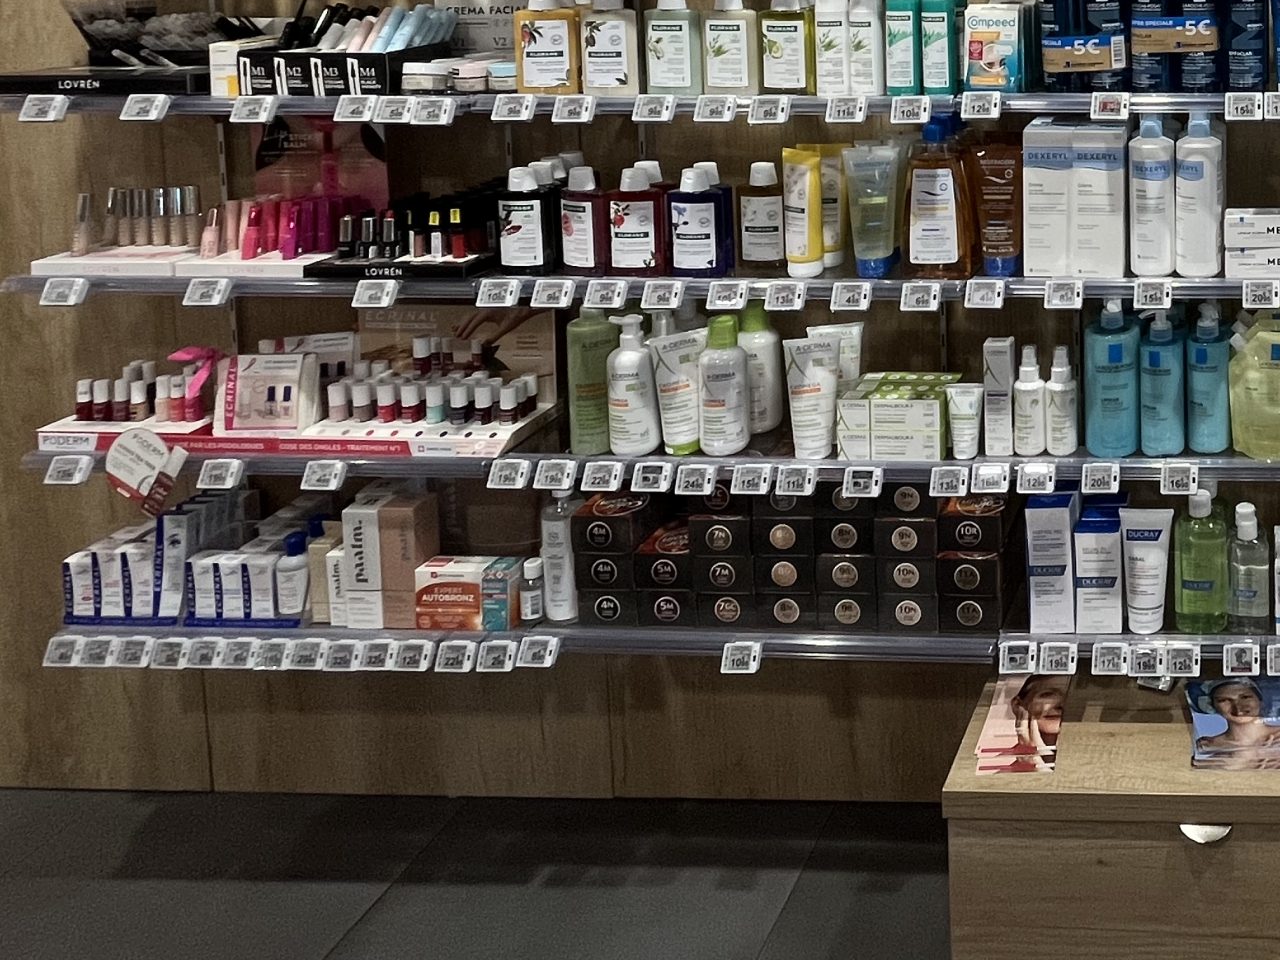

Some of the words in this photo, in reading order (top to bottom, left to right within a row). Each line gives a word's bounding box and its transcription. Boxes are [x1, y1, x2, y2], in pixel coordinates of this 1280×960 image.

[446, 5, 485, 15] CREMA
[967, 15, 1016, 31] Compeed
[1028, 152, 1068, 160] DEXERYL
[1077, 152, 1117, 161] DEXERYL
[1127, 529, 1160, 539] DUCRAY
[421, 594, 475, 603] AUTOBRONZ
